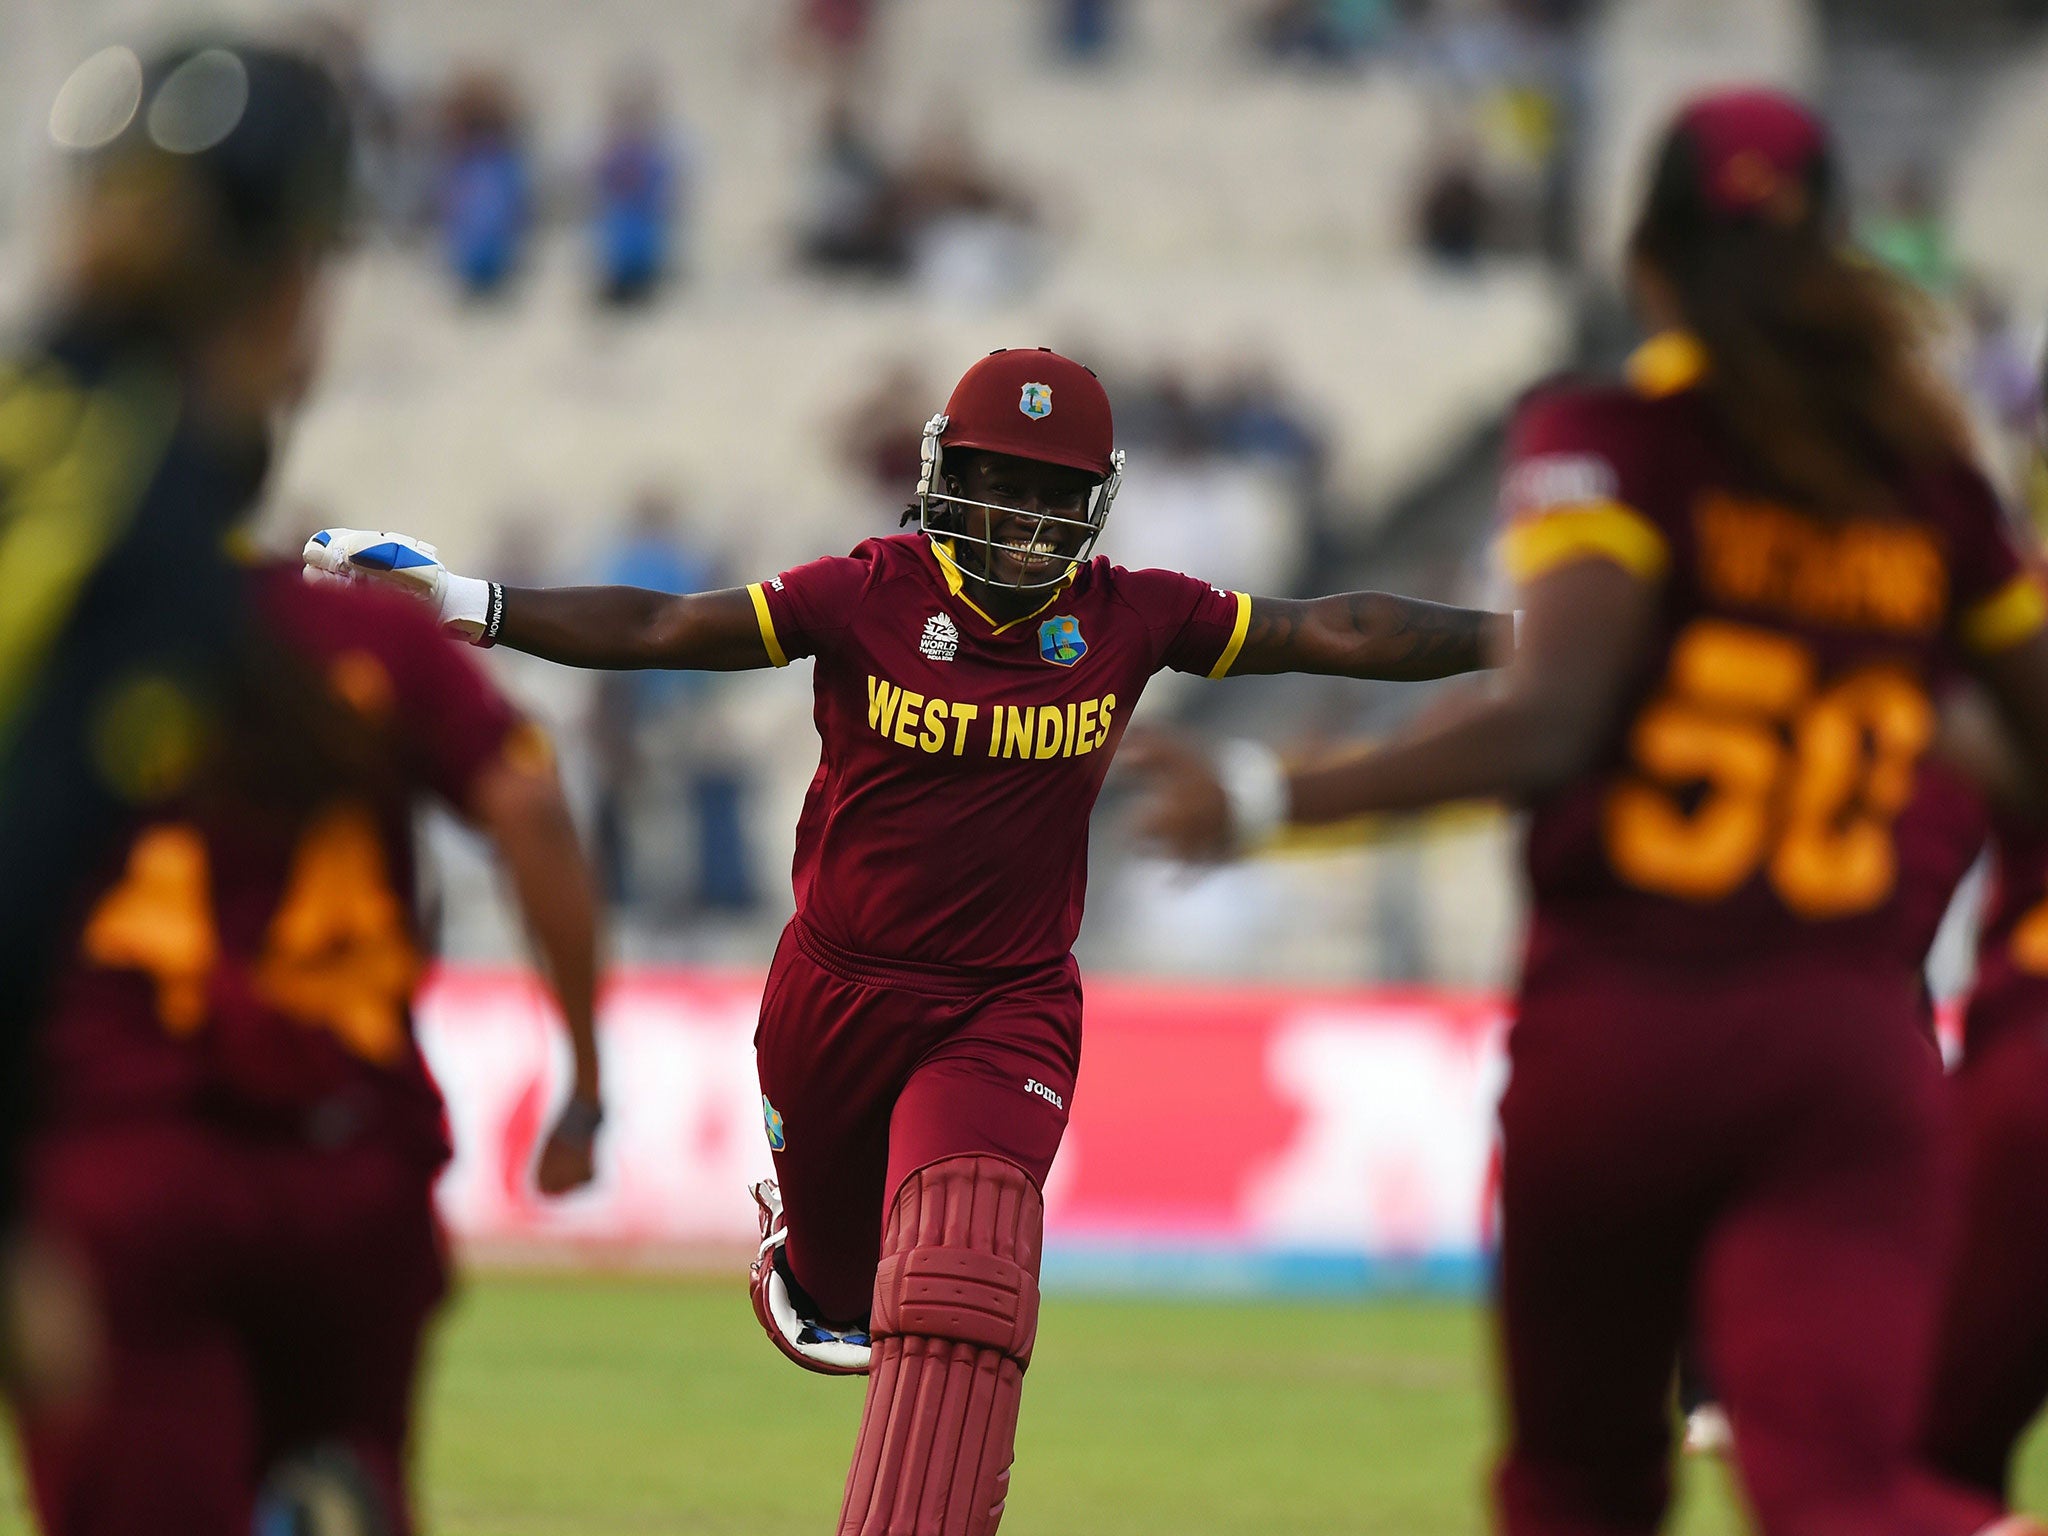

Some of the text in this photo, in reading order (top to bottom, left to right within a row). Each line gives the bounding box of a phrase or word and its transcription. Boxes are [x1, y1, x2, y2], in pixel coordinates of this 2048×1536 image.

[919, 647, 955, 656] TWENTY20
[921, 640, 957, 651] WORLD
[867, 674, 1117, 760] WEST INDIES
[1023, 1078, 1063, 1110] Joma
